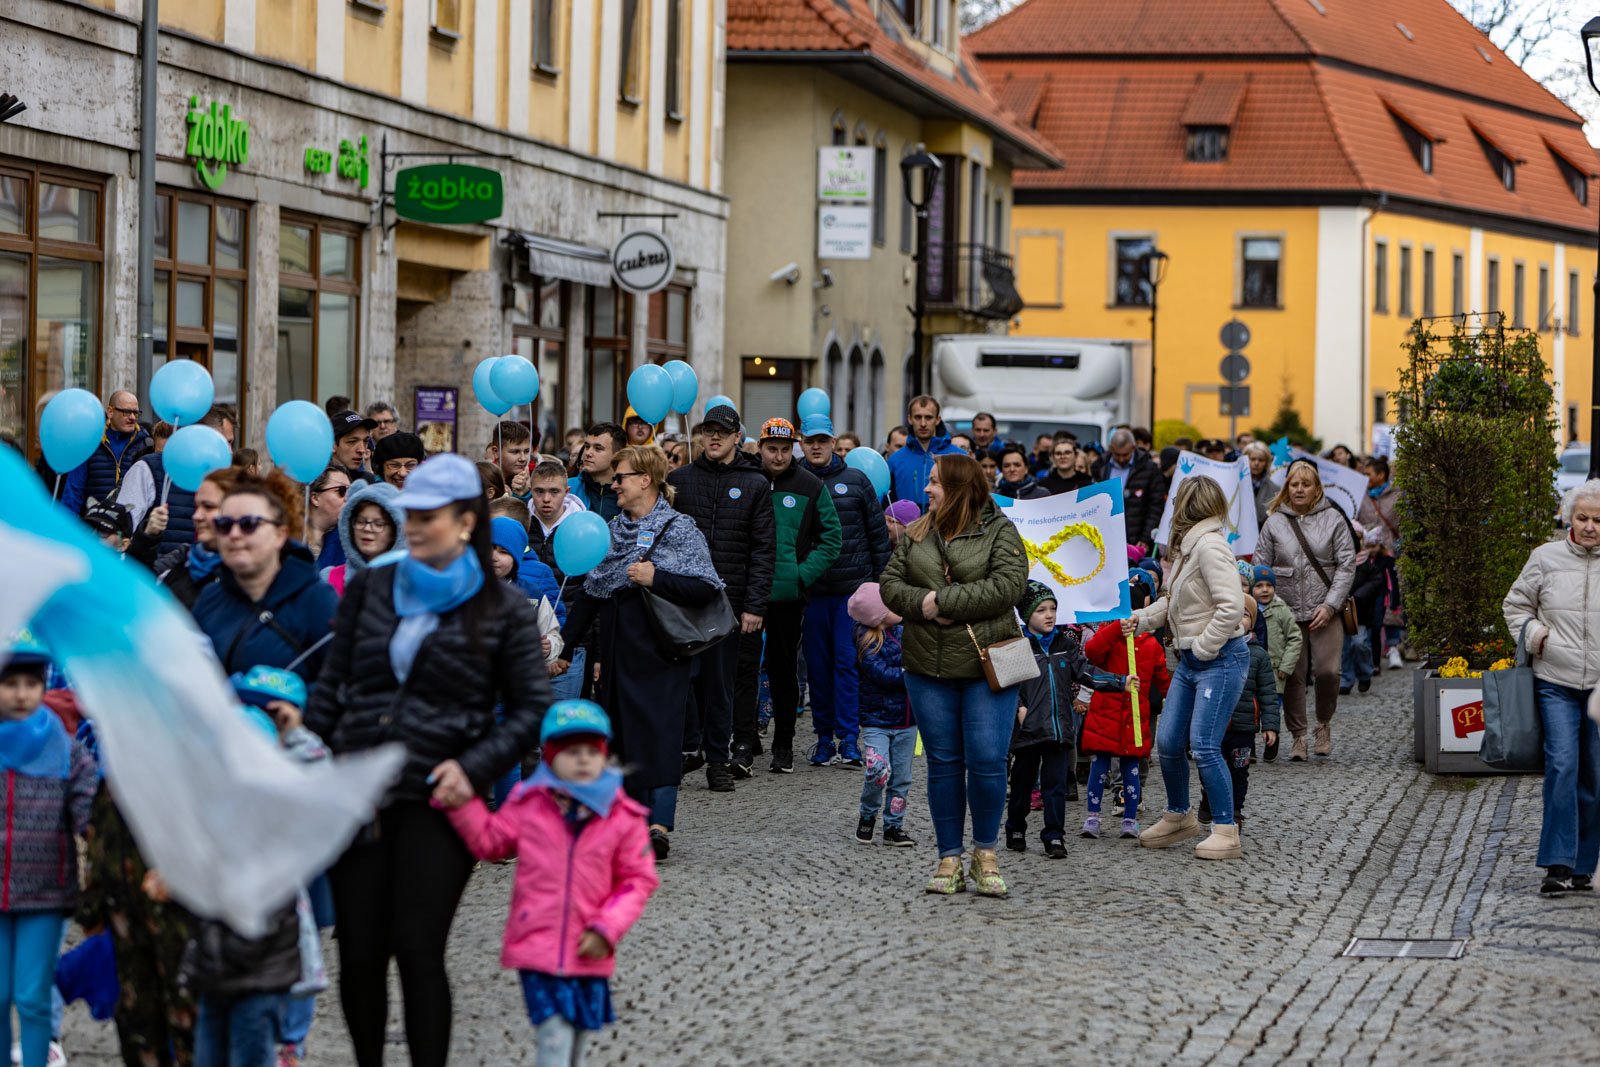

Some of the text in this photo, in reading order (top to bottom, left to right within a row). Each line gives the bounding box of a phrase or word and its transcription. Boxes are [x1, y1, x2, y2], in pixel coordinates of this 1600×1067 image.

[187, 95, 249, 165] żabka
[407, 175, 493, 199] żabka
[1028, 511, 1077, 525] nieskończenie
